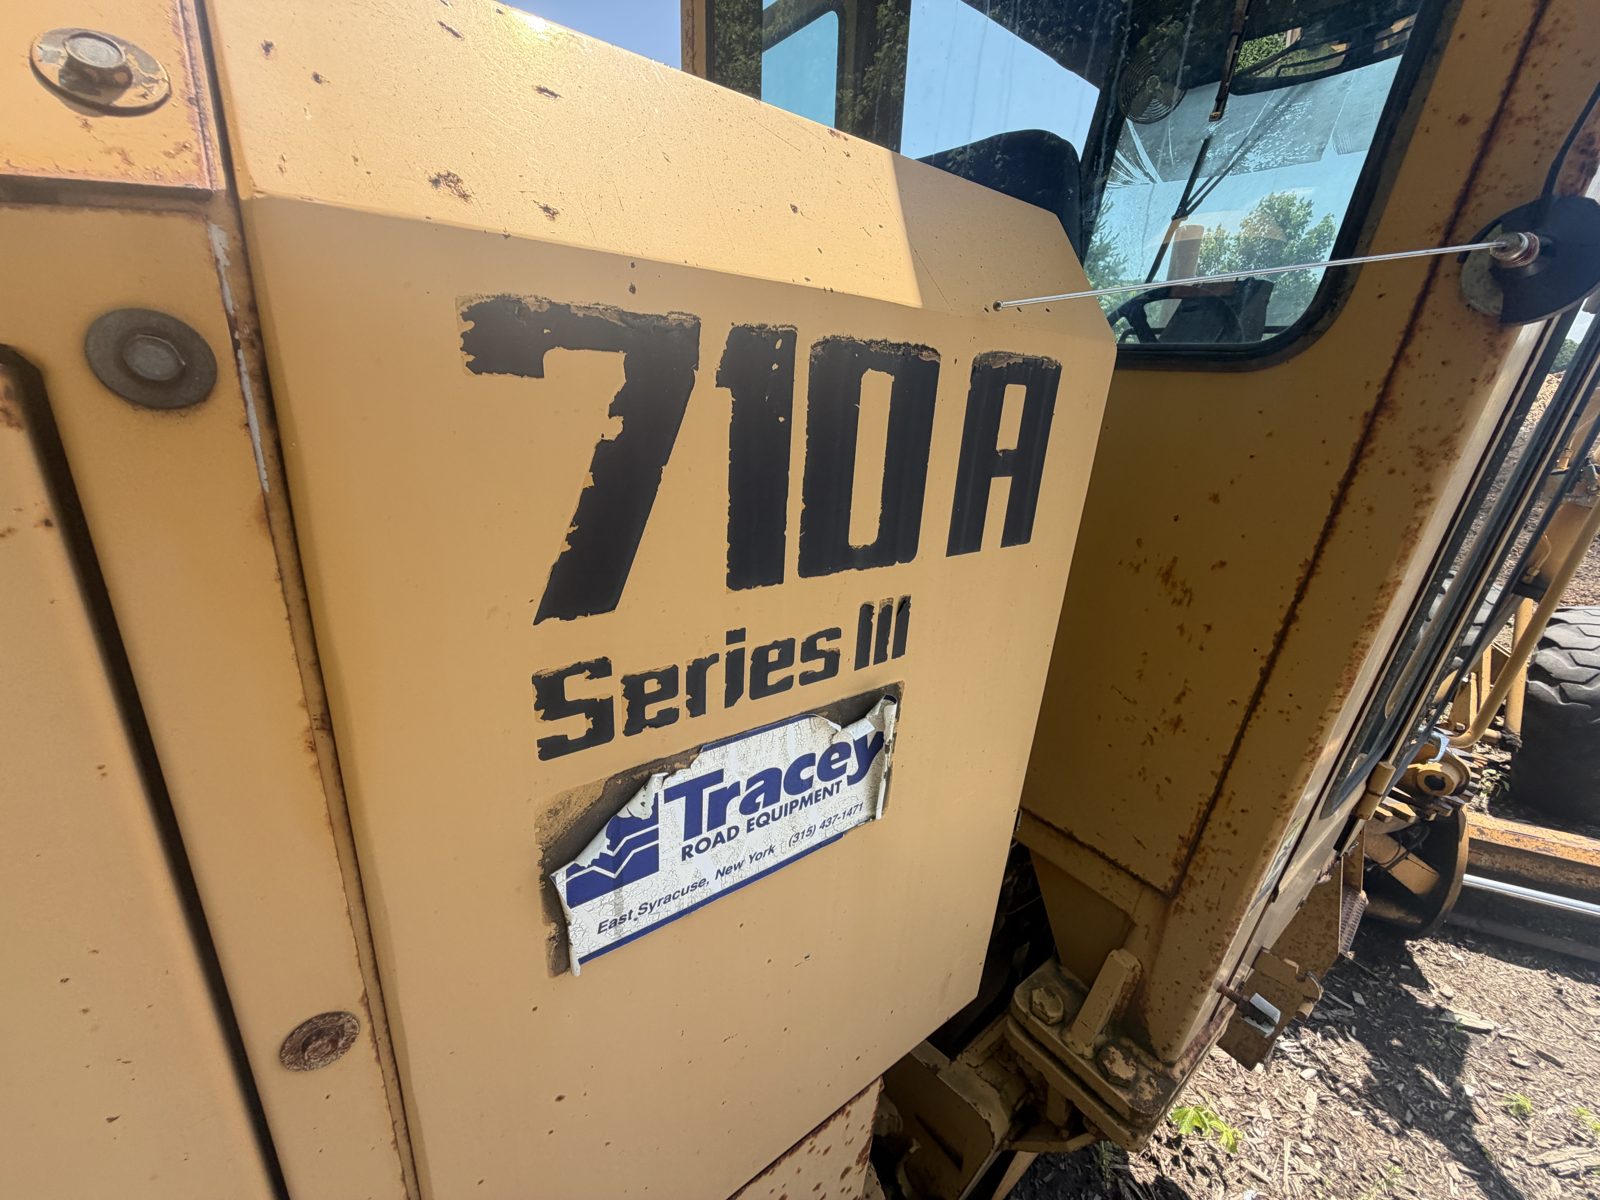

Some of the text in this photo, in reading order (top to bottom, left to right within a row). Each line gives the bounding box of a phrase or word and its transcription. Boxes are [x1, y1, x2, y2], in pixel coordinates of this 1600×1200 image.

[532, 595, 911, 761] Series III
[664, 731, 884, 841] Tracey
[681, 780, 842, 861] ROAD EQUIPMENT
[597, 803, 864, 934] East Syracuse, New York (315) 437-1471
